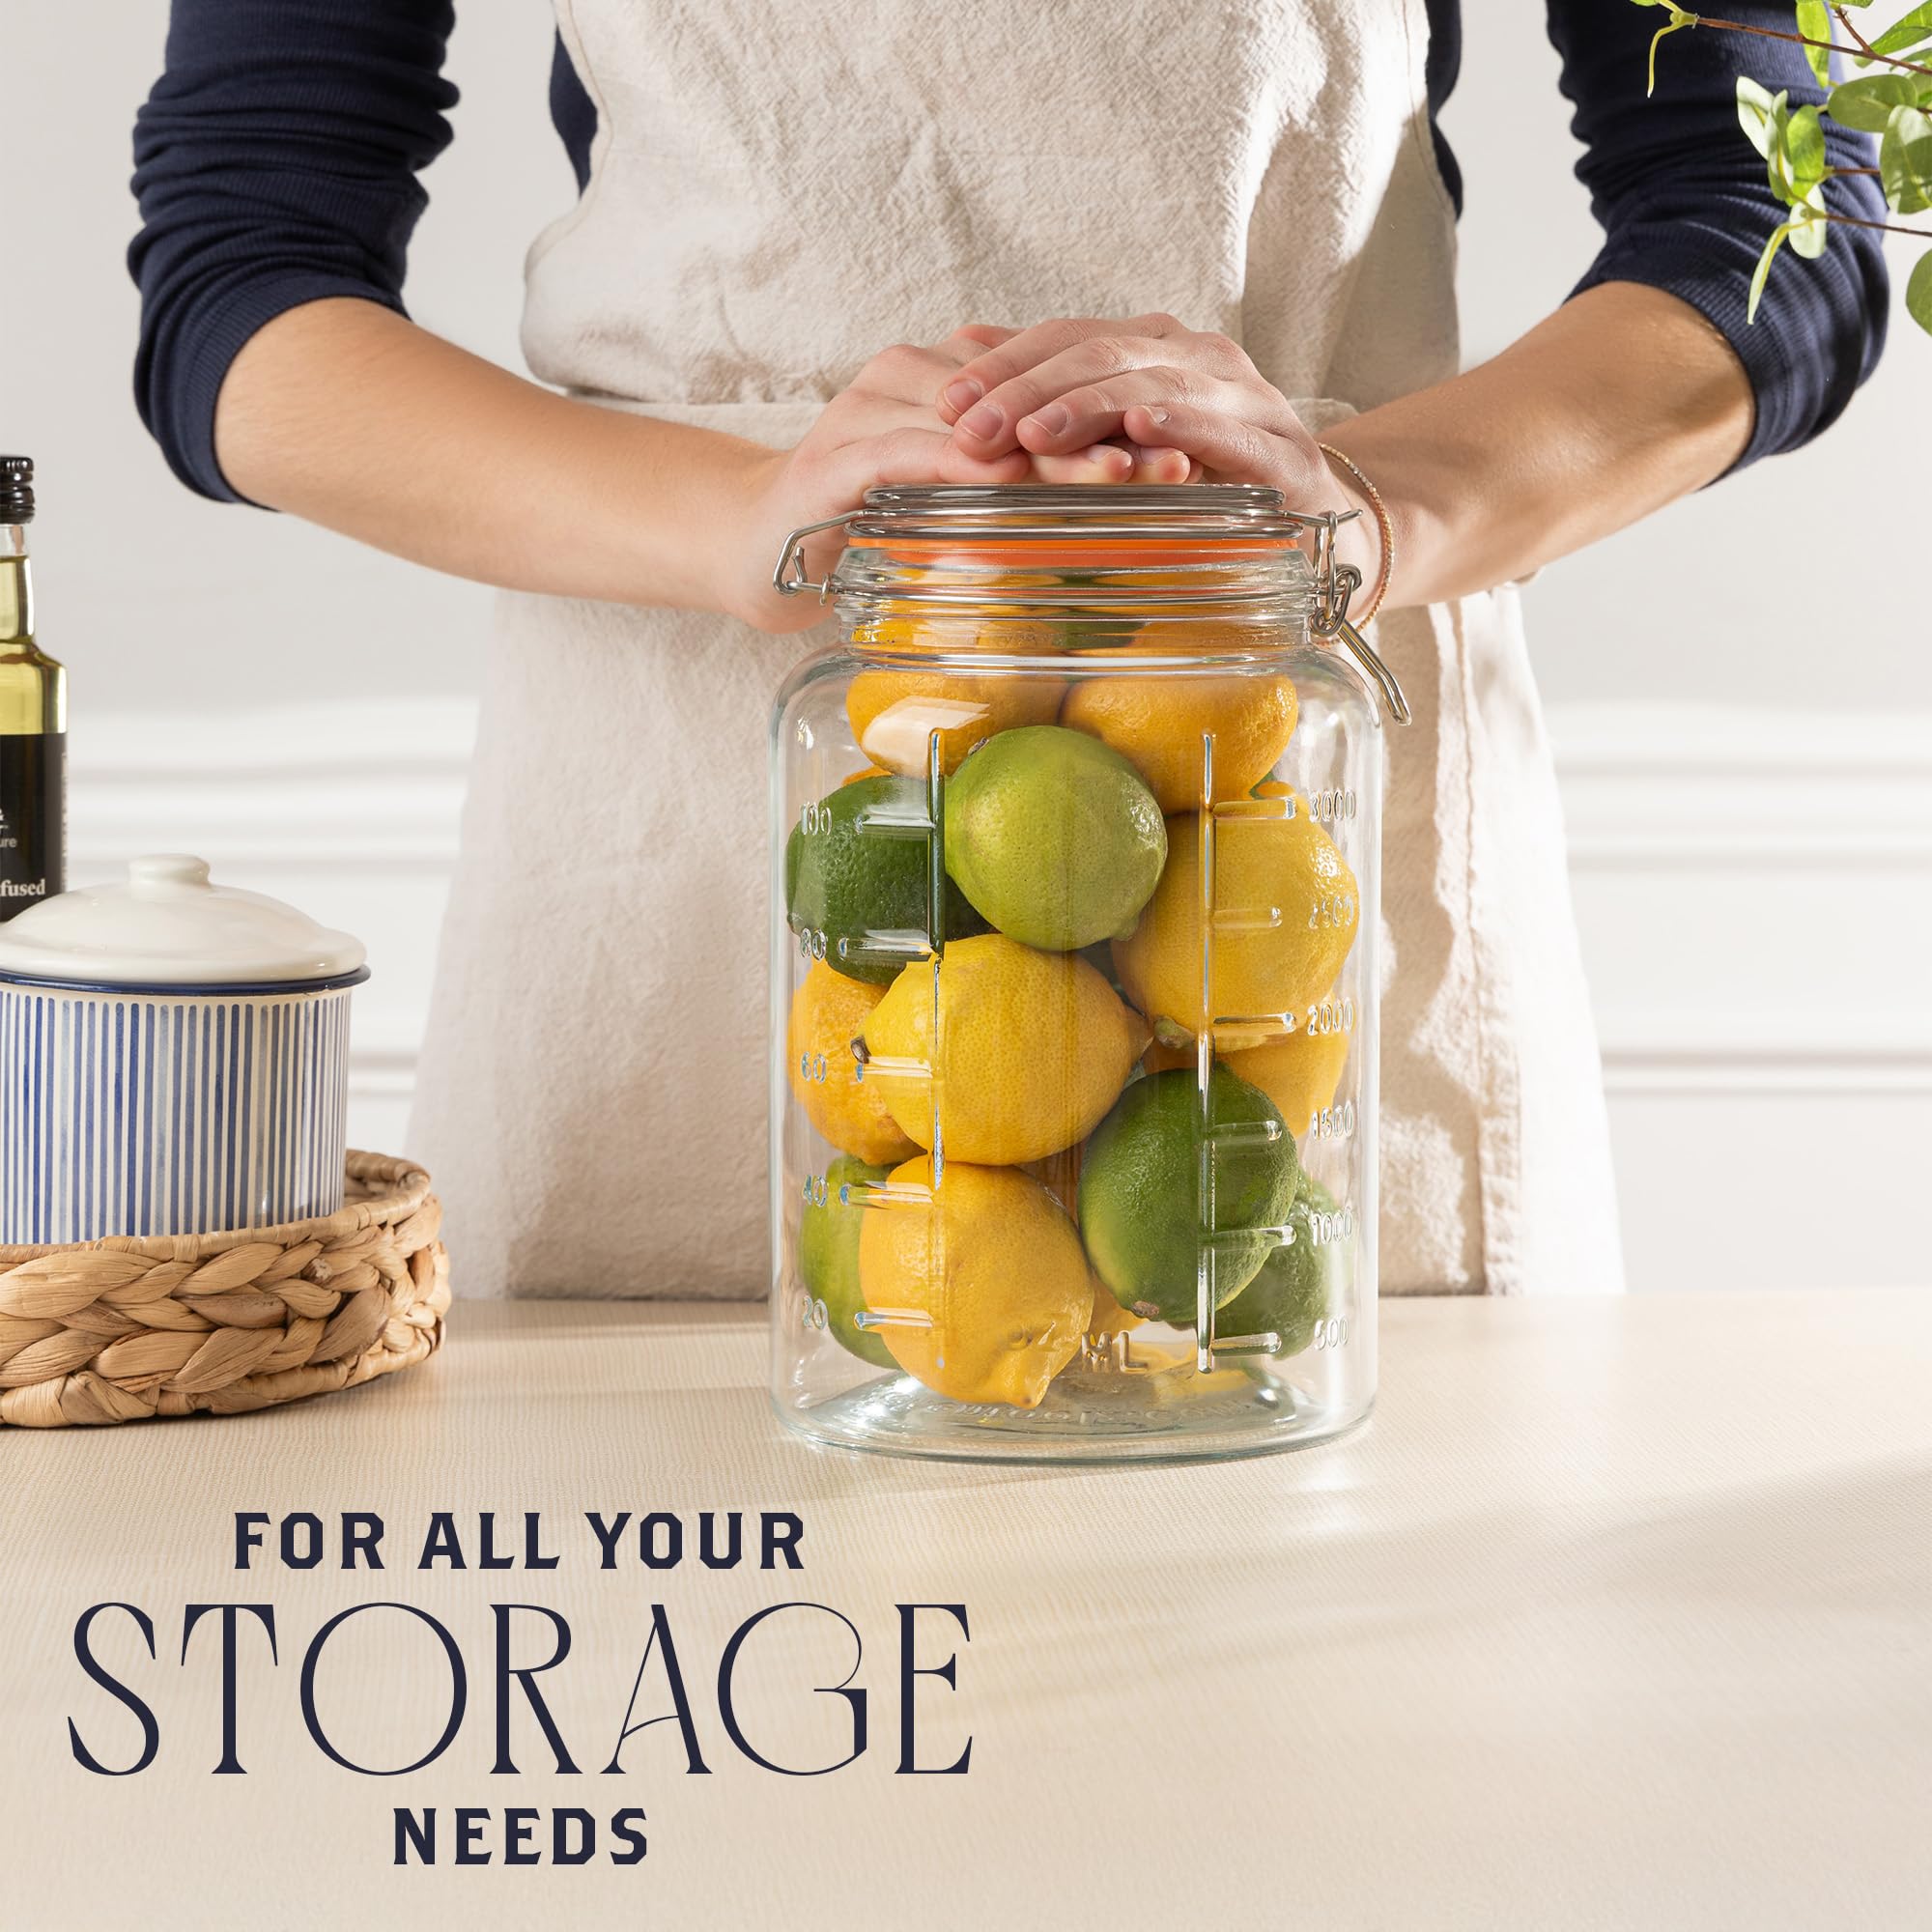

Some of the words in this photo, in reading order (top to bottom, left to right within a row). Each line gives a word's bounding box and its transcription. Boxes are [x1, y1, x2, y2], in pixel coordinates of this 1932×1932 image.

[800, 802, 833, 836] 100
[1309, 787, 1356, 822] 3000
[800, 927, 828, 961] 80
[1307, 996, 1354, 1037] 2000
[801, 1051, 827, 1083] 60
[1311, 1099, 1354, 1140] 1500
[802, 1174, 828, 1207] 40
[1311, 1204, 1353, 1246] 1000
[803, 1295, 829, 1329] 20
[1313, 1314, 1350, 1351] 500
[1080, 1329, 1150, 1375] ML
